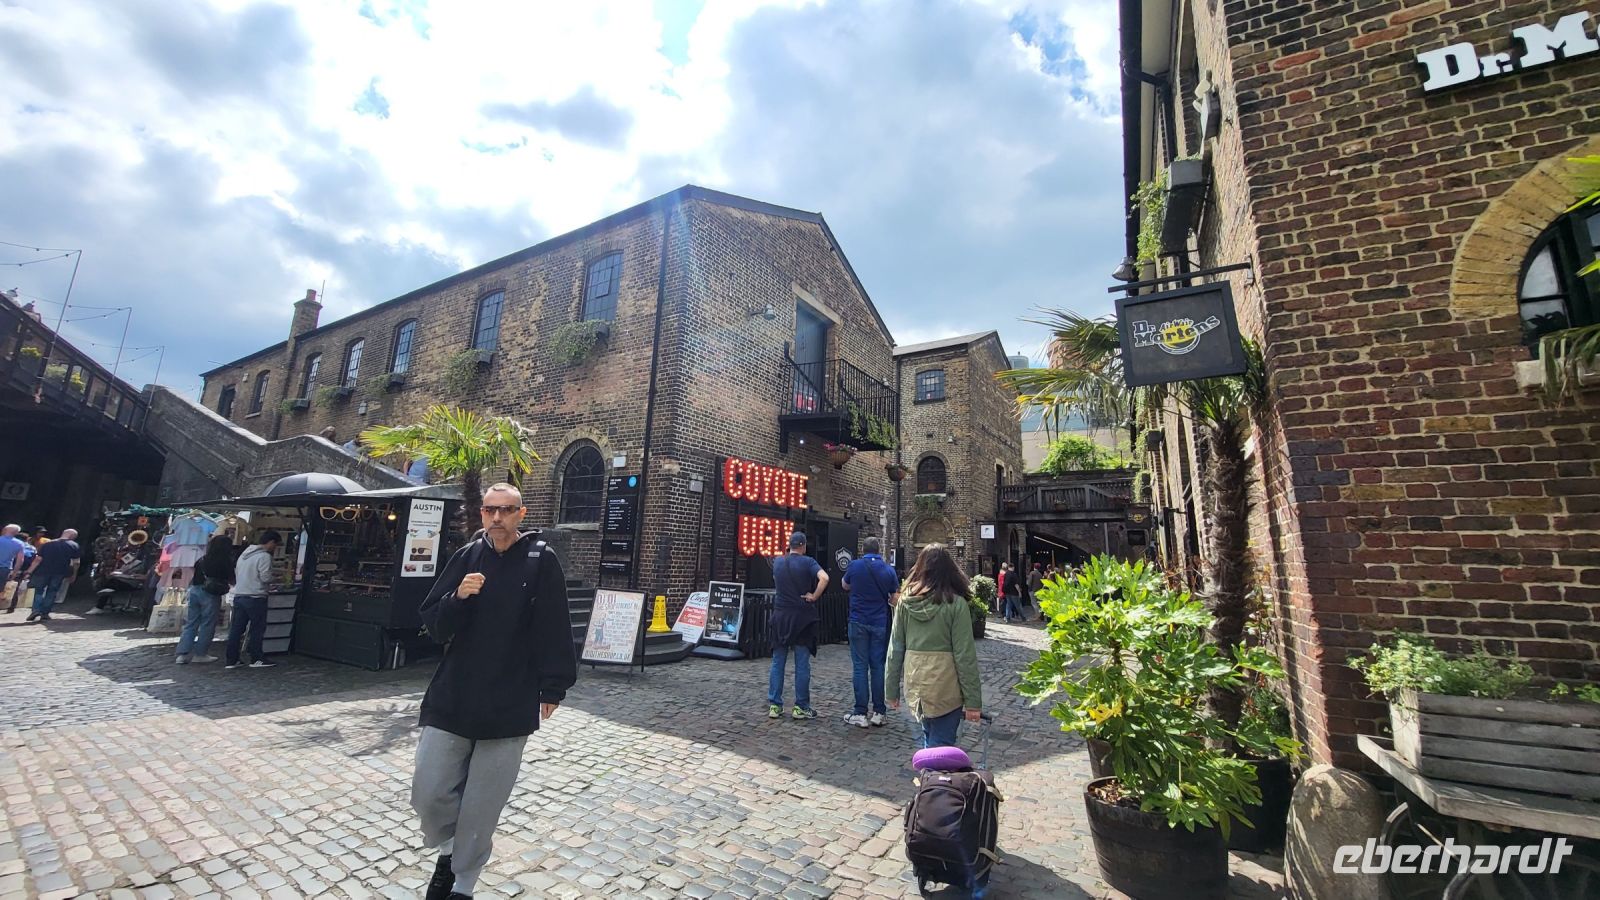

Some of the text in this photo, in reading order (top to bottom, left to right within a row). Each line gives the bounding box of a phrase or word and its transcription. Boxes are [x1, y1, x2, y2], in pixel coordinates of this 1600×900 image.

[1133, 320, 1156, 334] Dr.
[1134, 315, 1221, 348] Martens
[724, 456, 809, 509] COYOTE
[413, 503, 442, 511] AUSTIN
[738, 514, 794, 557] UGLY
